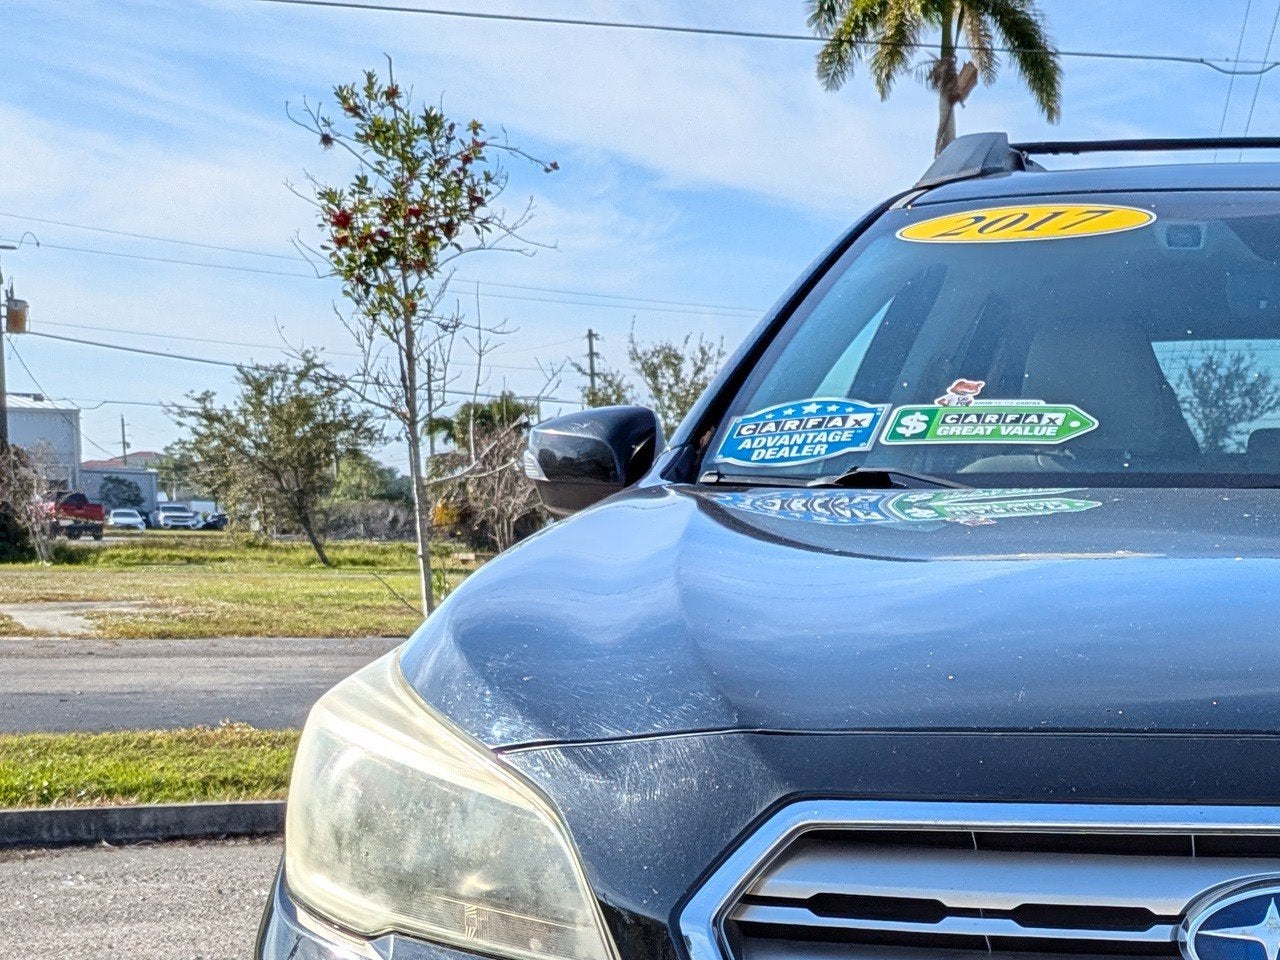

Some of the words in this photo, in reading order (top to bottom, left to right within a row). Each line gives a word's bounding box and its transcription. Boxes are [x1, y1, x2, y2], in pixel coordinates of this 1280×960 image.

[930, 210, 1115, 238] 2017
[740, 417, 867, 435] CARFAX
[944, 413, 1060, 425] CARFAX
[936, 425, 998, 436] GREAT
[1000, 426, 1059, 436] VALUE
[737, 430, 856, 450] ADVANTAGE
[750, 444, 828, 461] DEALER
